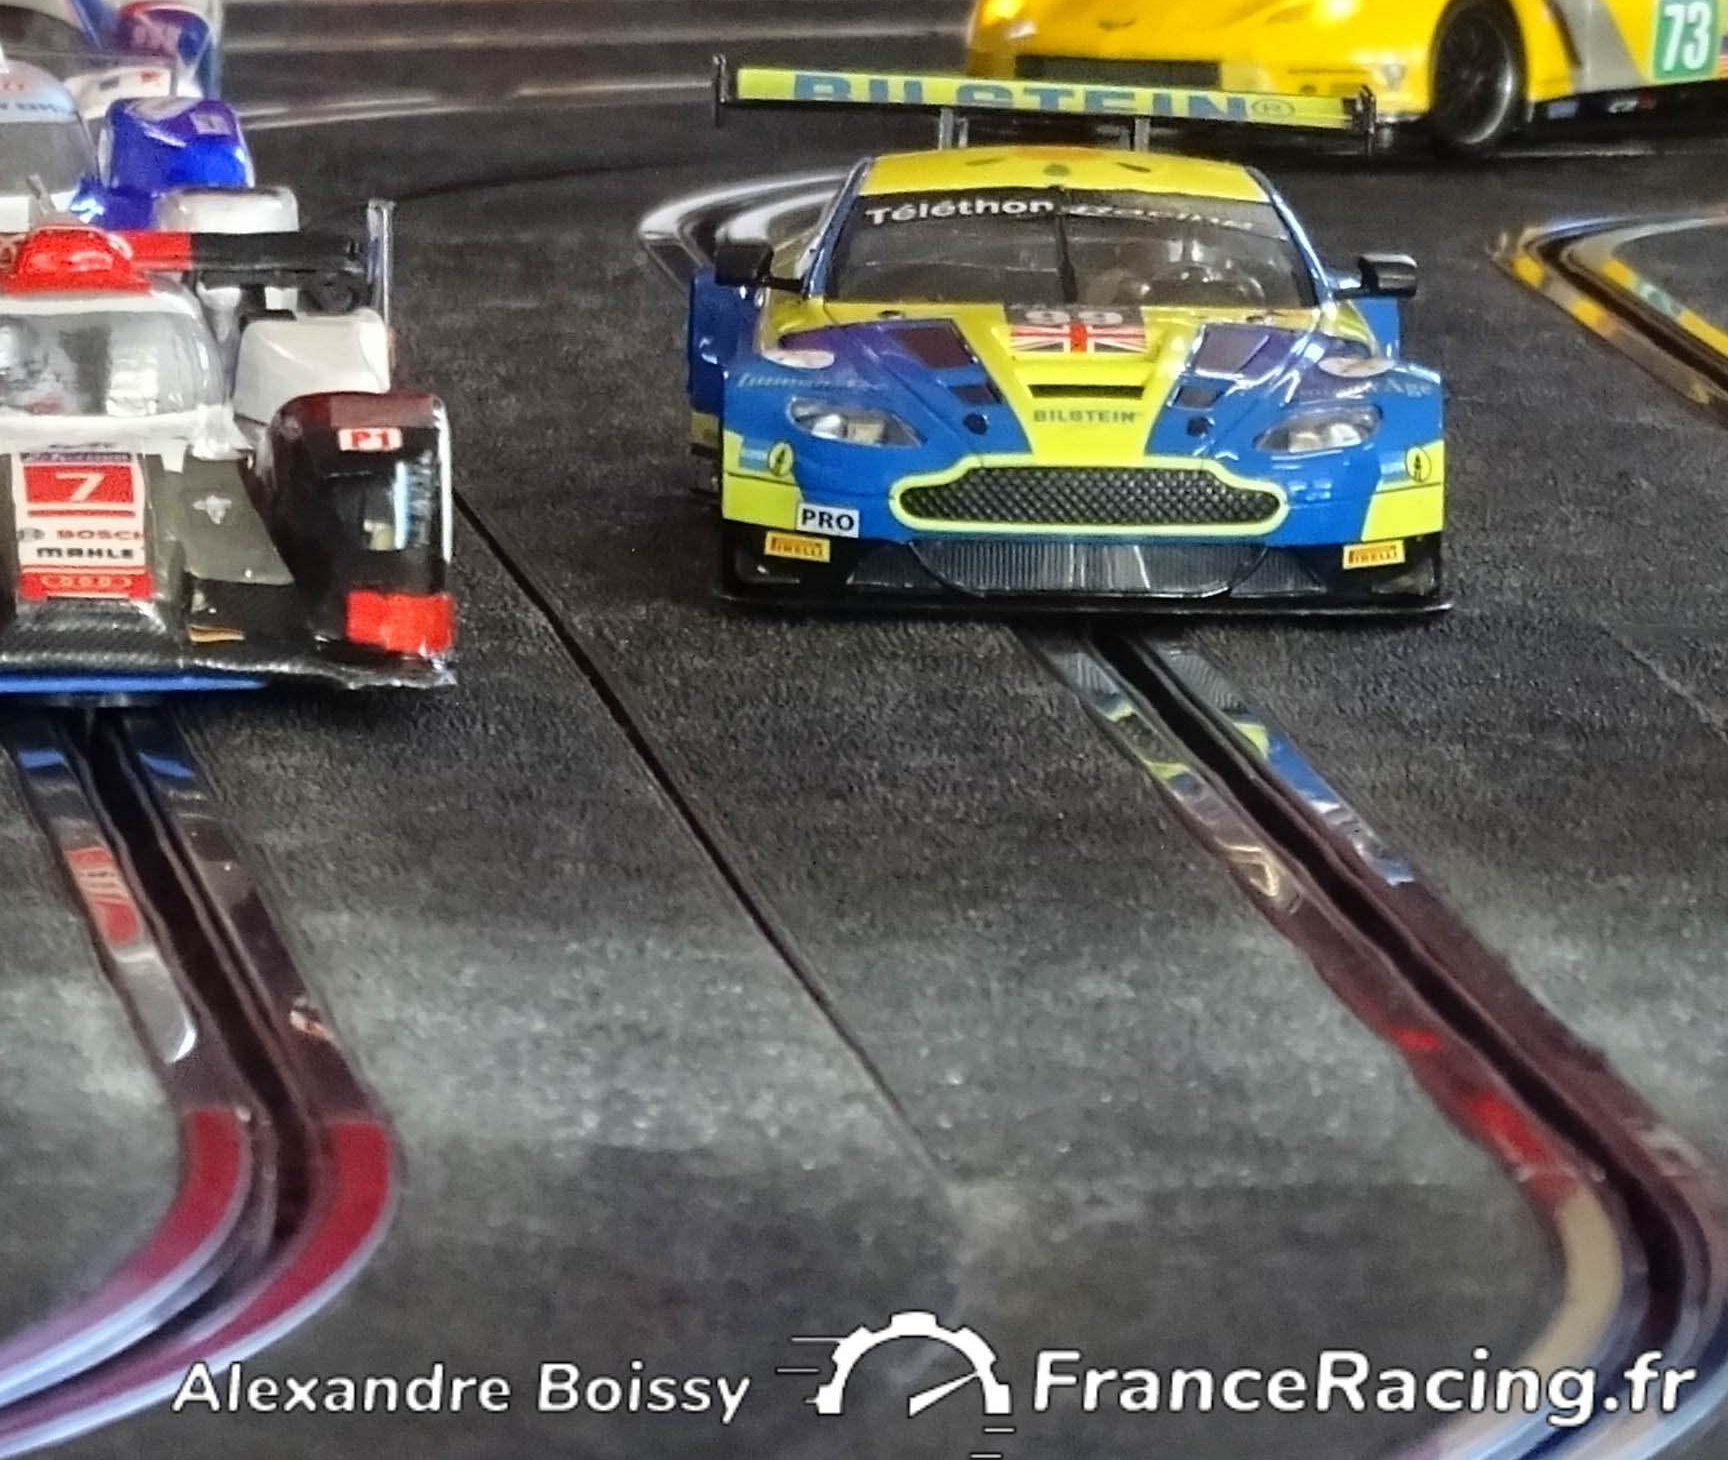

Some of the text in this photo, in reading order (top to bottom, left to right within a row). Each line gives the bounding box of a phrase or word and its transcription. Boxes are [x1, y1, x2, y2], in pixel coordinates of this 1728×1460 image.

[1662, 1, 1712, 71] 73
[866, 198, 1055, 226] Téléthon
[1033, 410, 1136, 423] BILSTEIN
[352, 431, 389, 447] P1
[55, 472, 105, 502] 7
[801, 508, 855, 531] PRO
